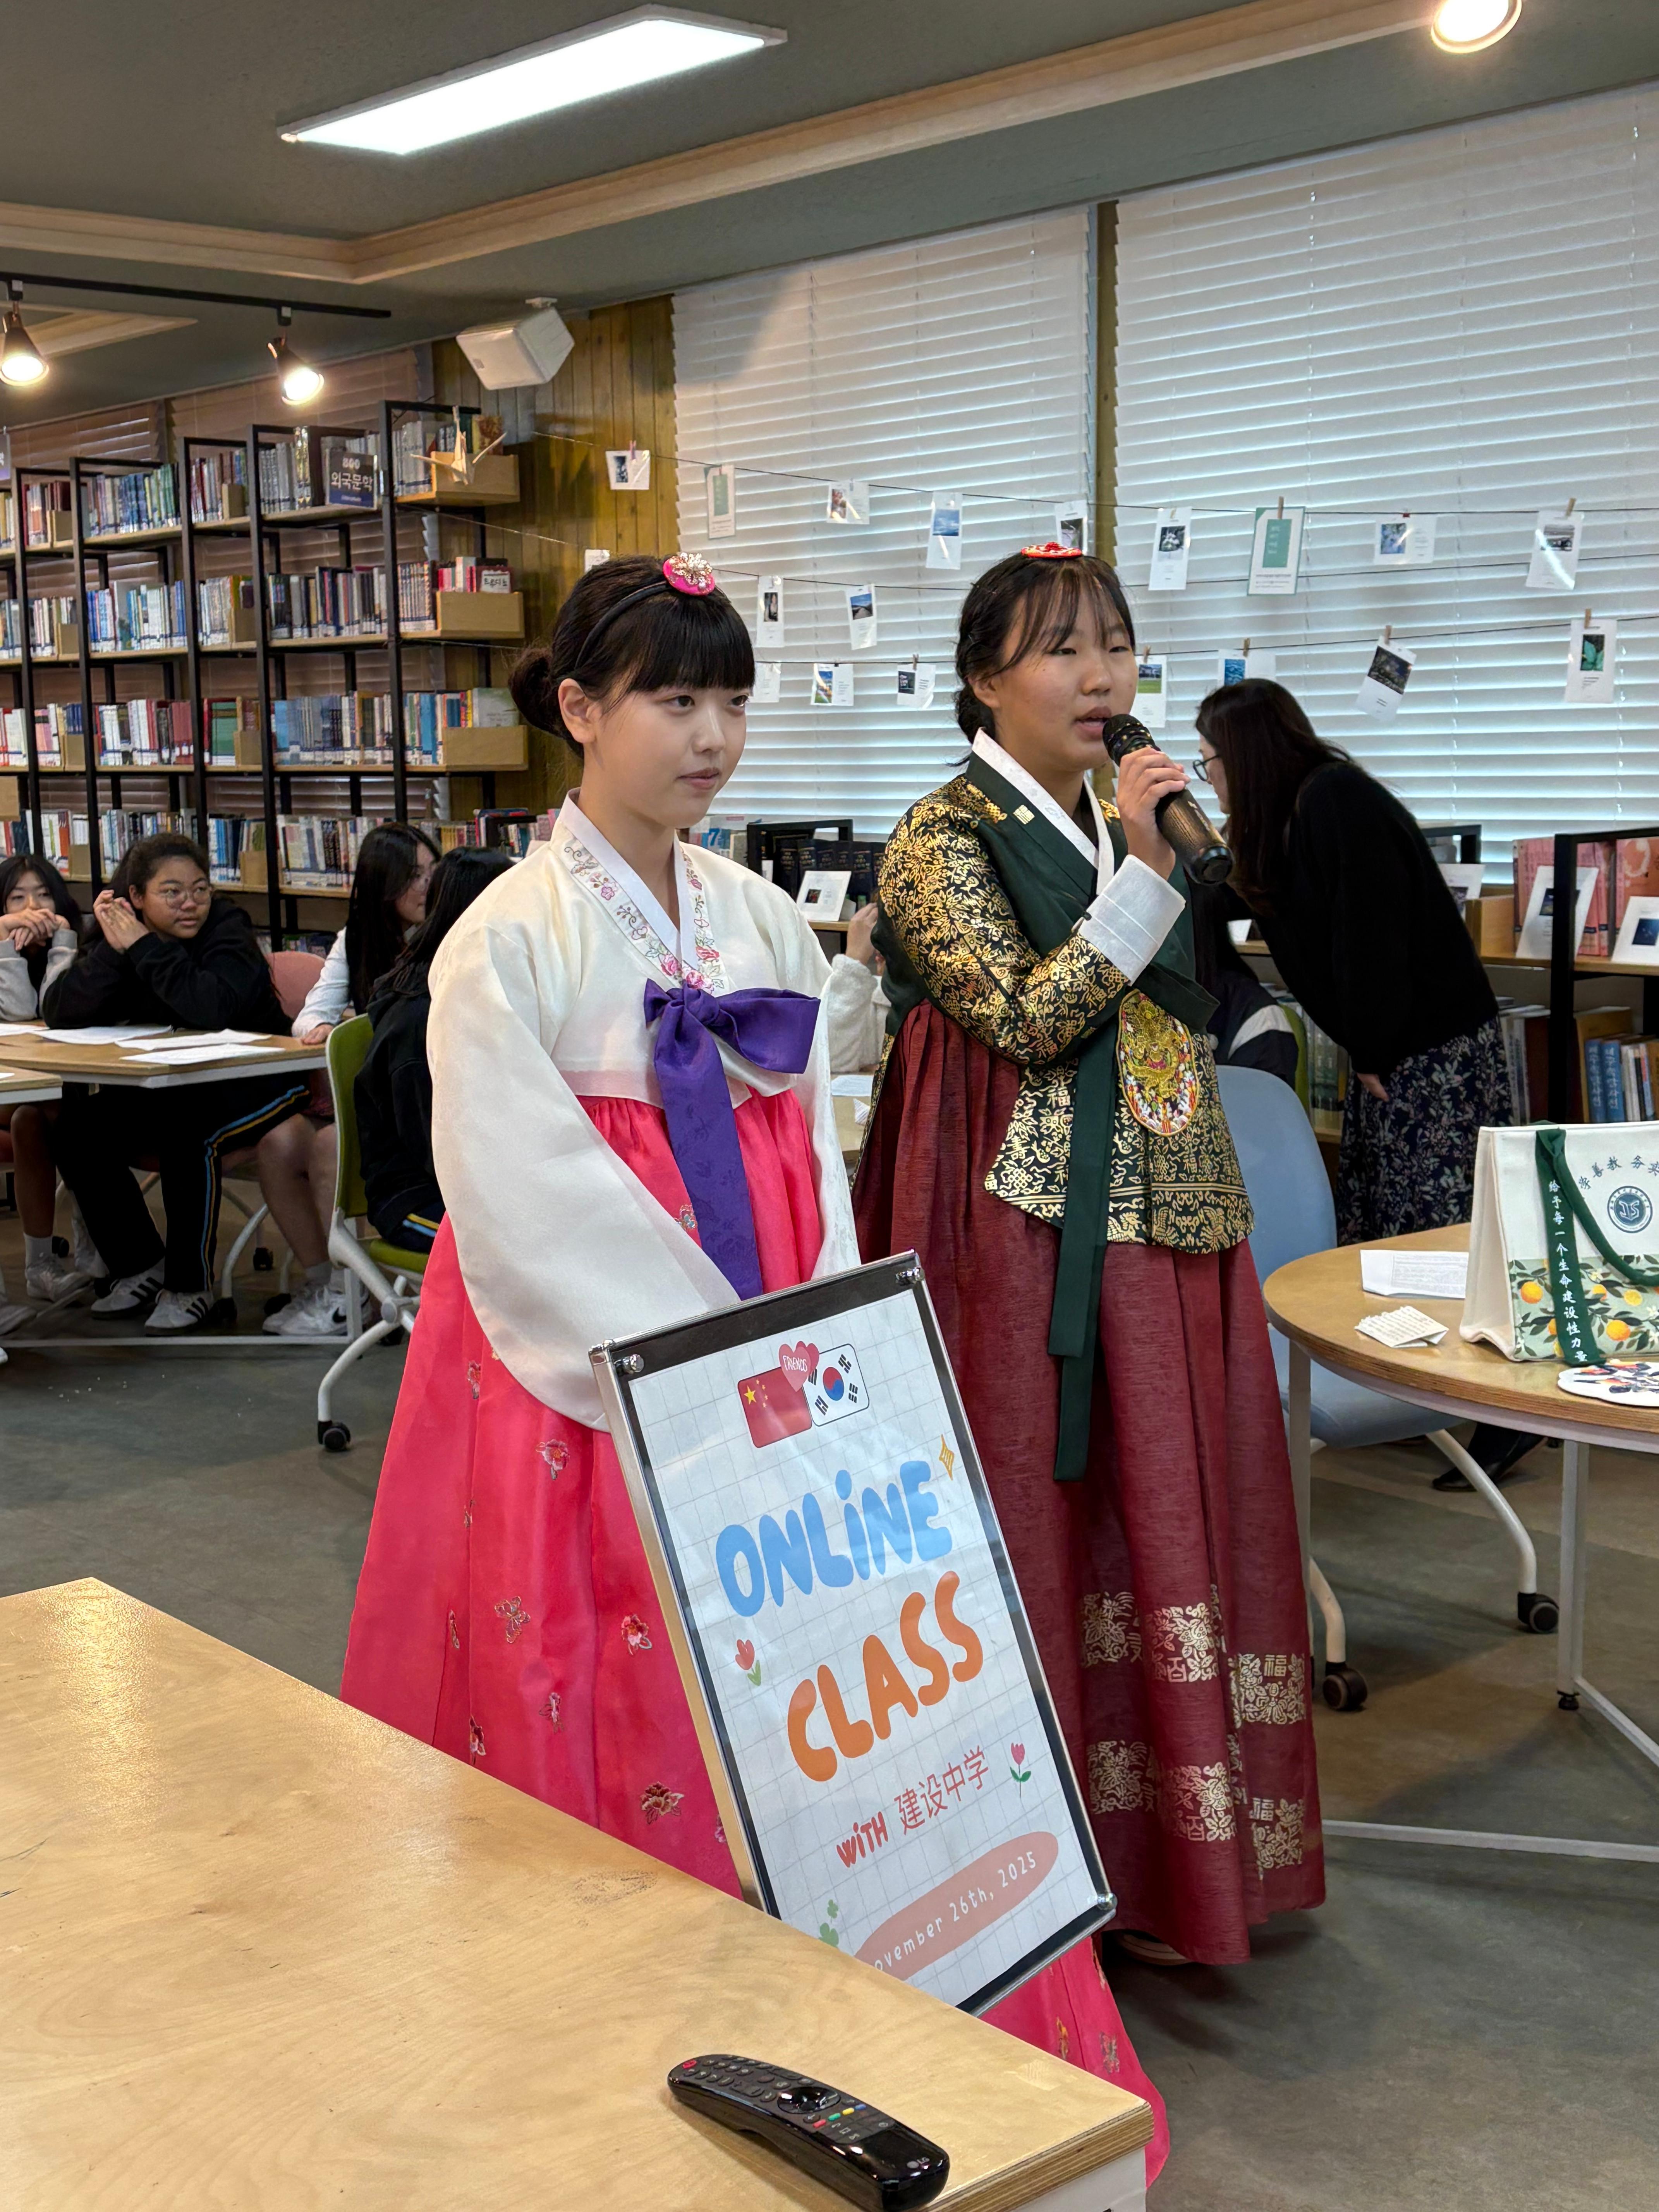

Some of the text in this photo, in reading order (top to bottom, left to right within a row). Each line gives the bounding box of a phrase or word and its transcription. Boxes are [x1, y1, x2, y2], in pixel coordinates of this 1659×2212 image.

[331, 472, 373, 492] 외국문학
[1046, 1086, 1070, 1109] 福
[1549, 1179, 1588, 1362] 给予每一个生命建设性力量
[783, 1355, 808, 1372] FRIENDS
[787, 1570, 983, 1782] CLASS
[1264, 1654, 1287, 1677] 福
[894, 1745, 989, 1835] 建设中学
[1249, 1797, 1274, 1821] 福
[874, 1851, 1036, 1972] ovember 26th, 2025
